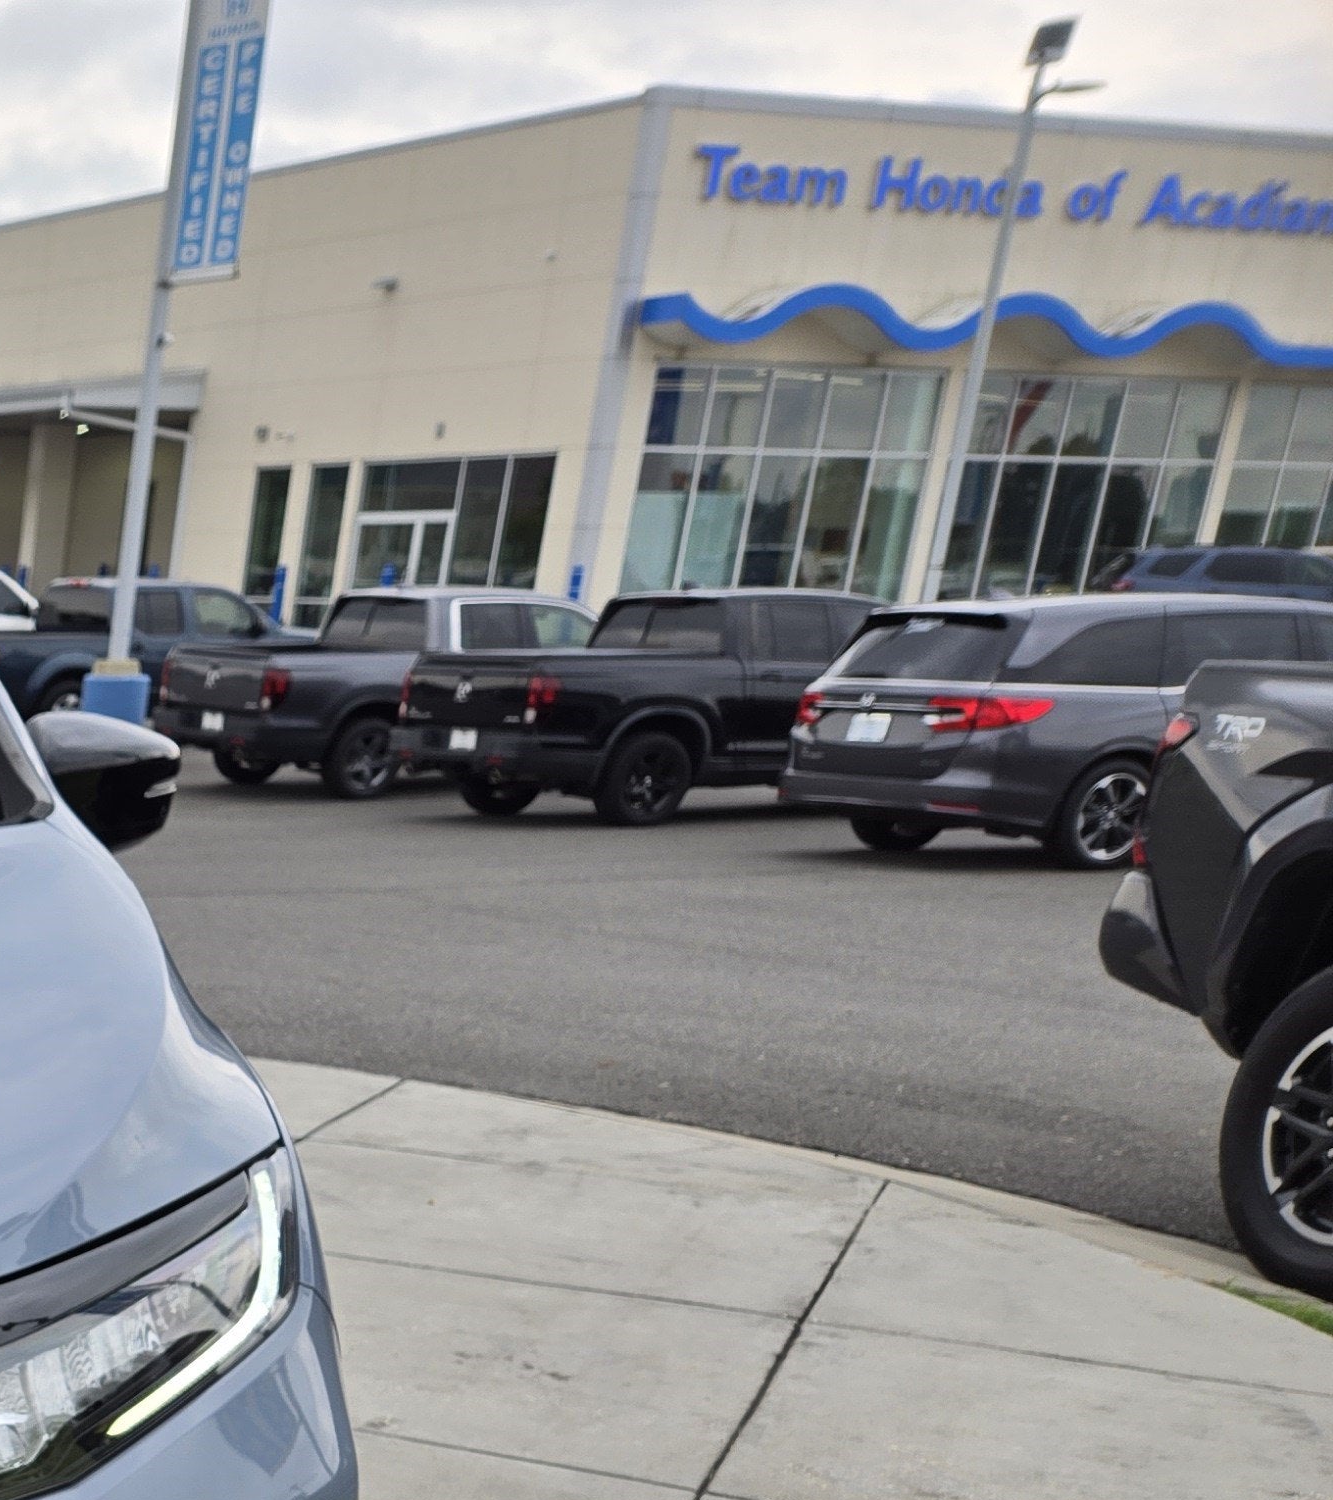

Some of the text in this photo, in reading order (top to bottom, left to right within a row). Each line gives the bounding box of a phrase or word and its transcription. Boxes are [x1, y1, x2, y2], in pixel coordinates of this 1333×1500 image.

[697, 143, 847, 206] Team
[1067, 170, 1128, 221] of
[1215, 713, 1266, 742] TRD
